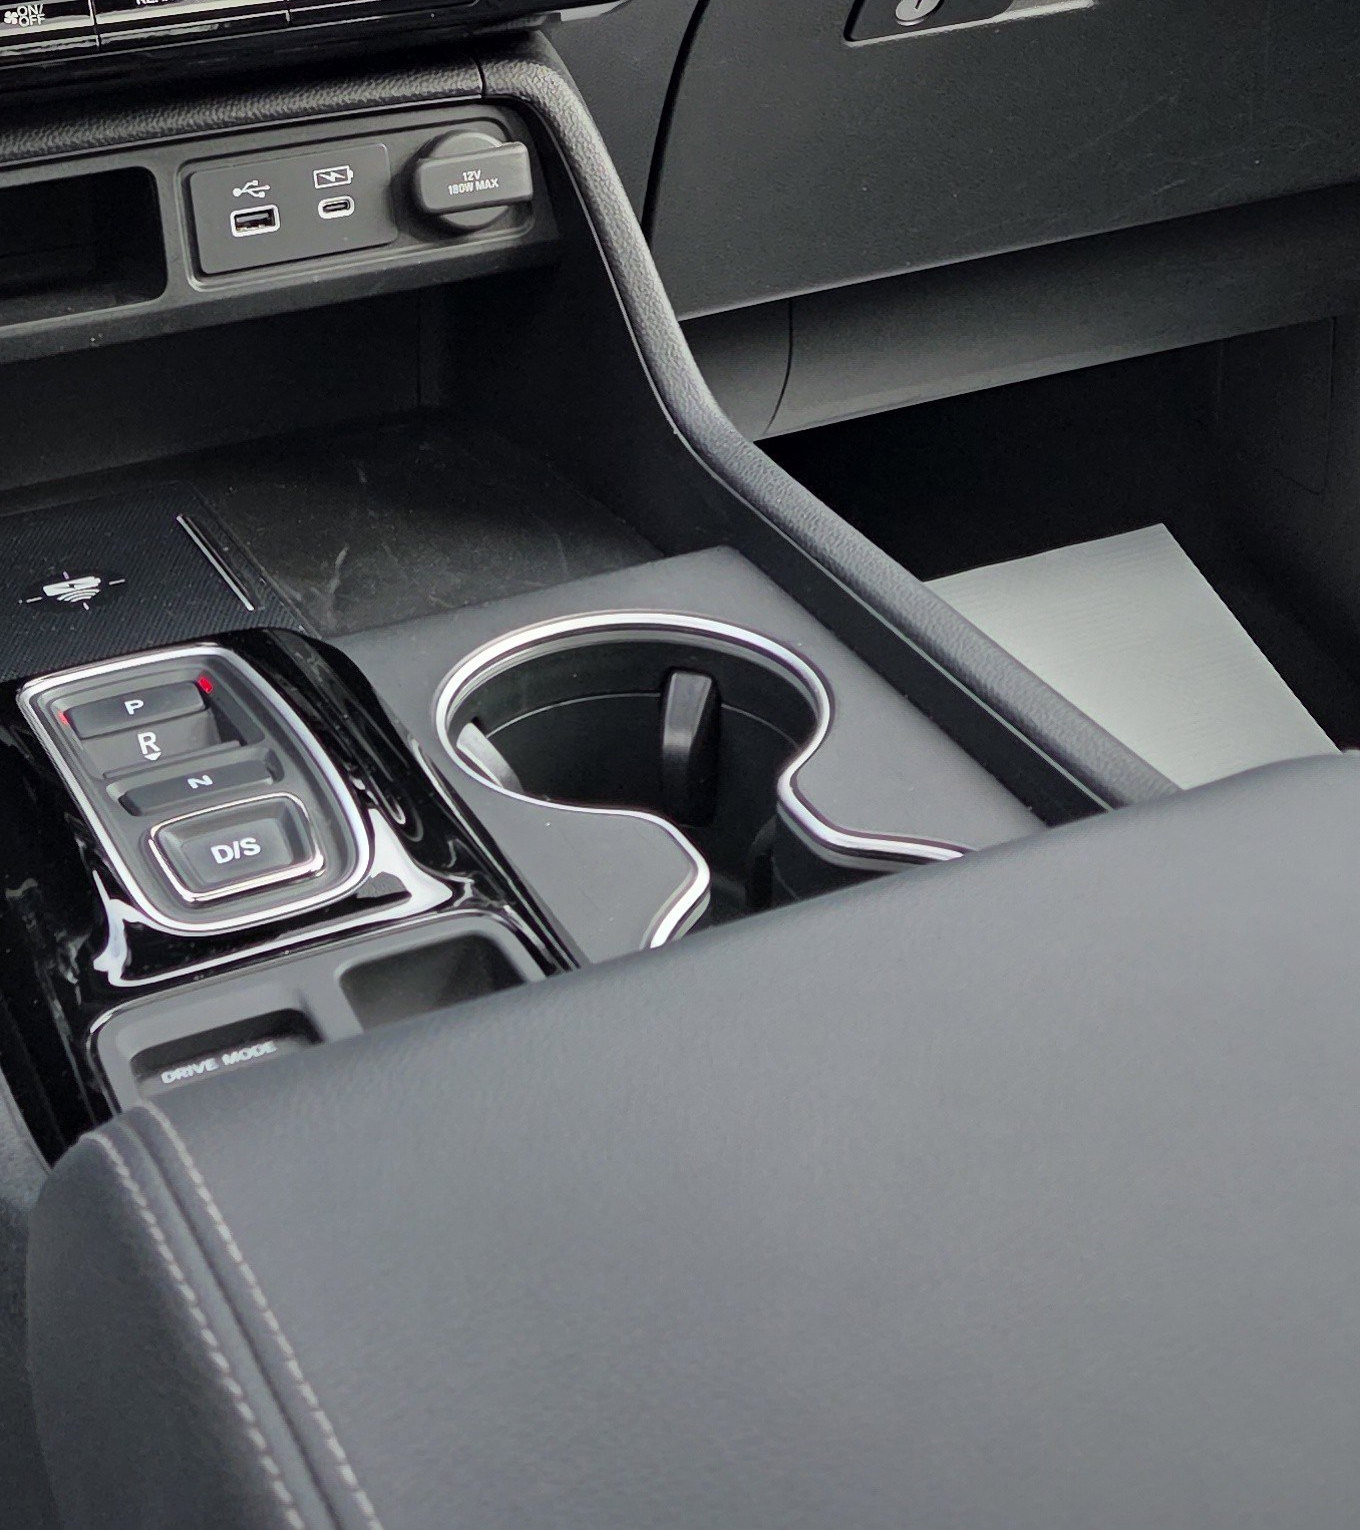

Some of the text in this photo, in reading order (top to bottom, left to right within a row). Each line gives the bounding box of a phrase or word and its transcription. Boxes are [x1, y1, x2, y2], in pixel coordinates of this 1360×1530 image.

[17, 4, 44, 17] ON/
[19, 13, 46, 26] OFF
[462, 170, 481, 181] 12V
[448, 178, 499, 195] 180W MAX
[124, 699, 144, 715] P
[137, 732, 161, 755] R
[187, 775, 213, 789] N
[211, 837, 262, 865] D/S
[161, 1041, 277, 1083] DRIVE MODE
